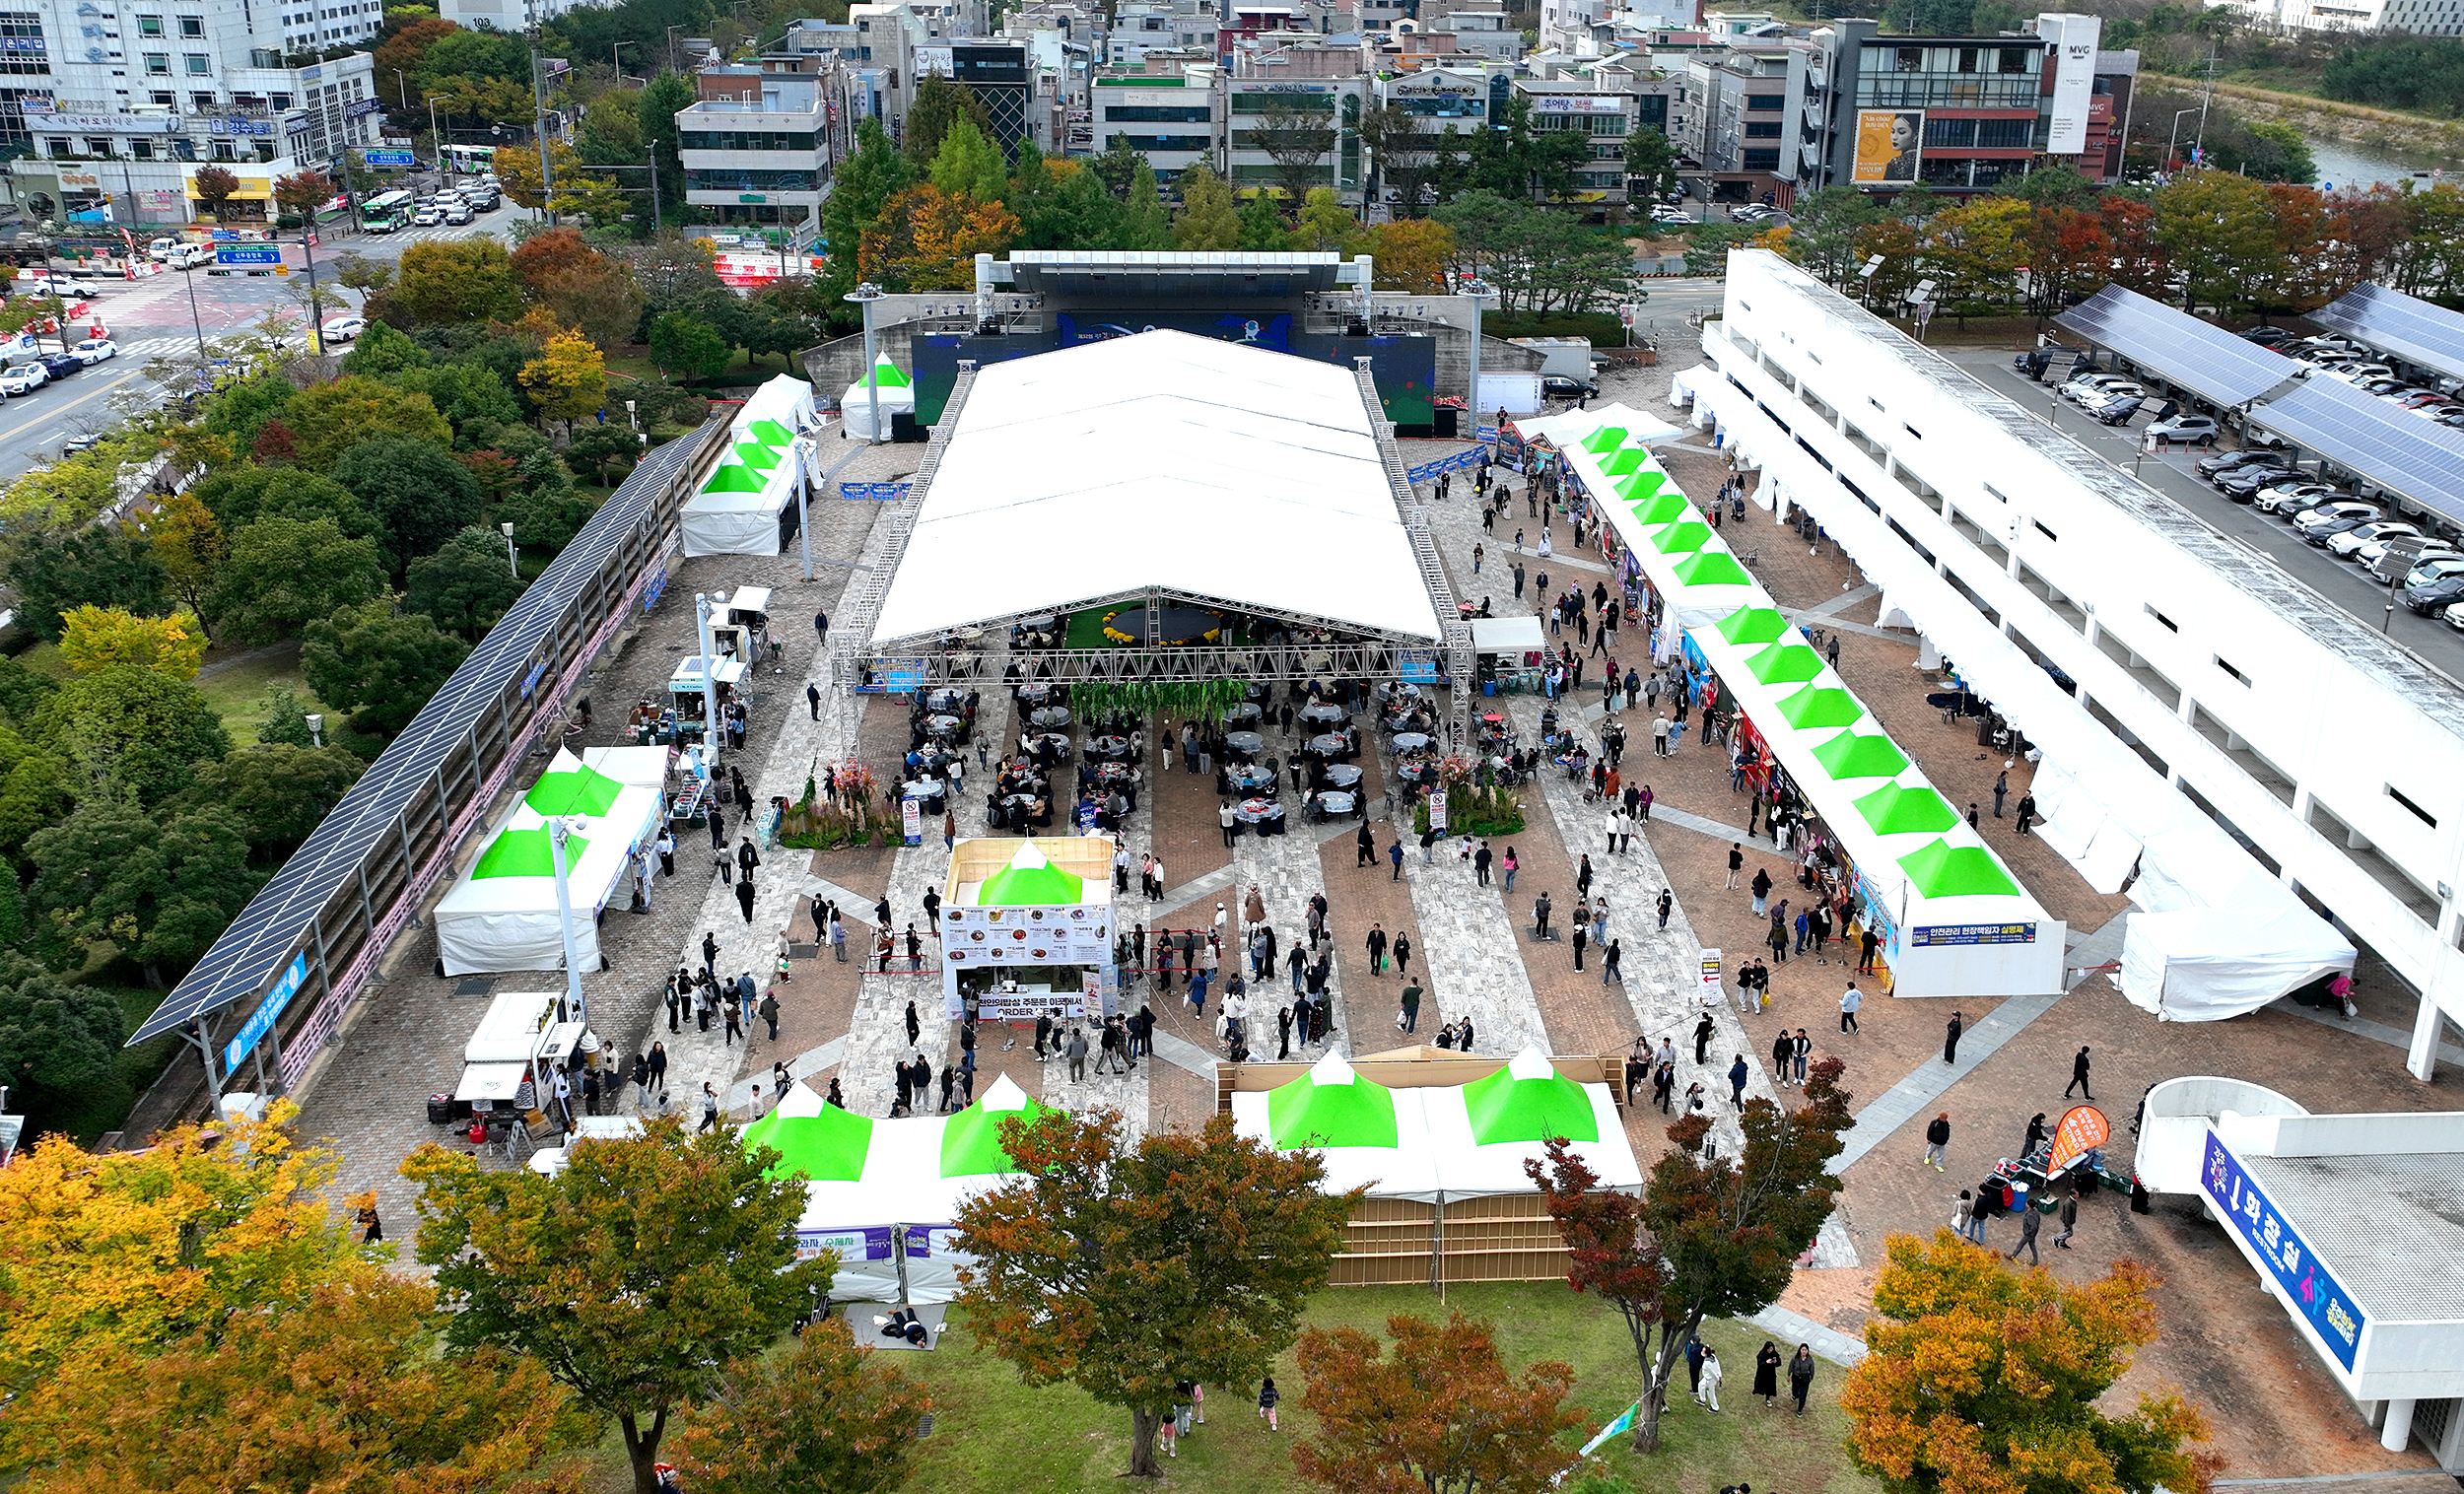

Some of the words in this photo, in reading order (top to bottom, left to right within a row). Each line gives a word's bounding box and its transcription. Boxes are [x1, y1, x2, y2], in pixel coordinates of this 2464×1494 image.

[473, 17, 491, 27] 103
[2069, 45, 2090, 54] MVG
[1930, 927, 1960, 936] 안전관리
[1023, 997, 1048, 1006] 주문은
[2073, 1128, 2088, 1149] 반납은
[2243, 1189, 2301, 1275] 화장실
[2251, 1227, 2286, 1273] RESTROOM
